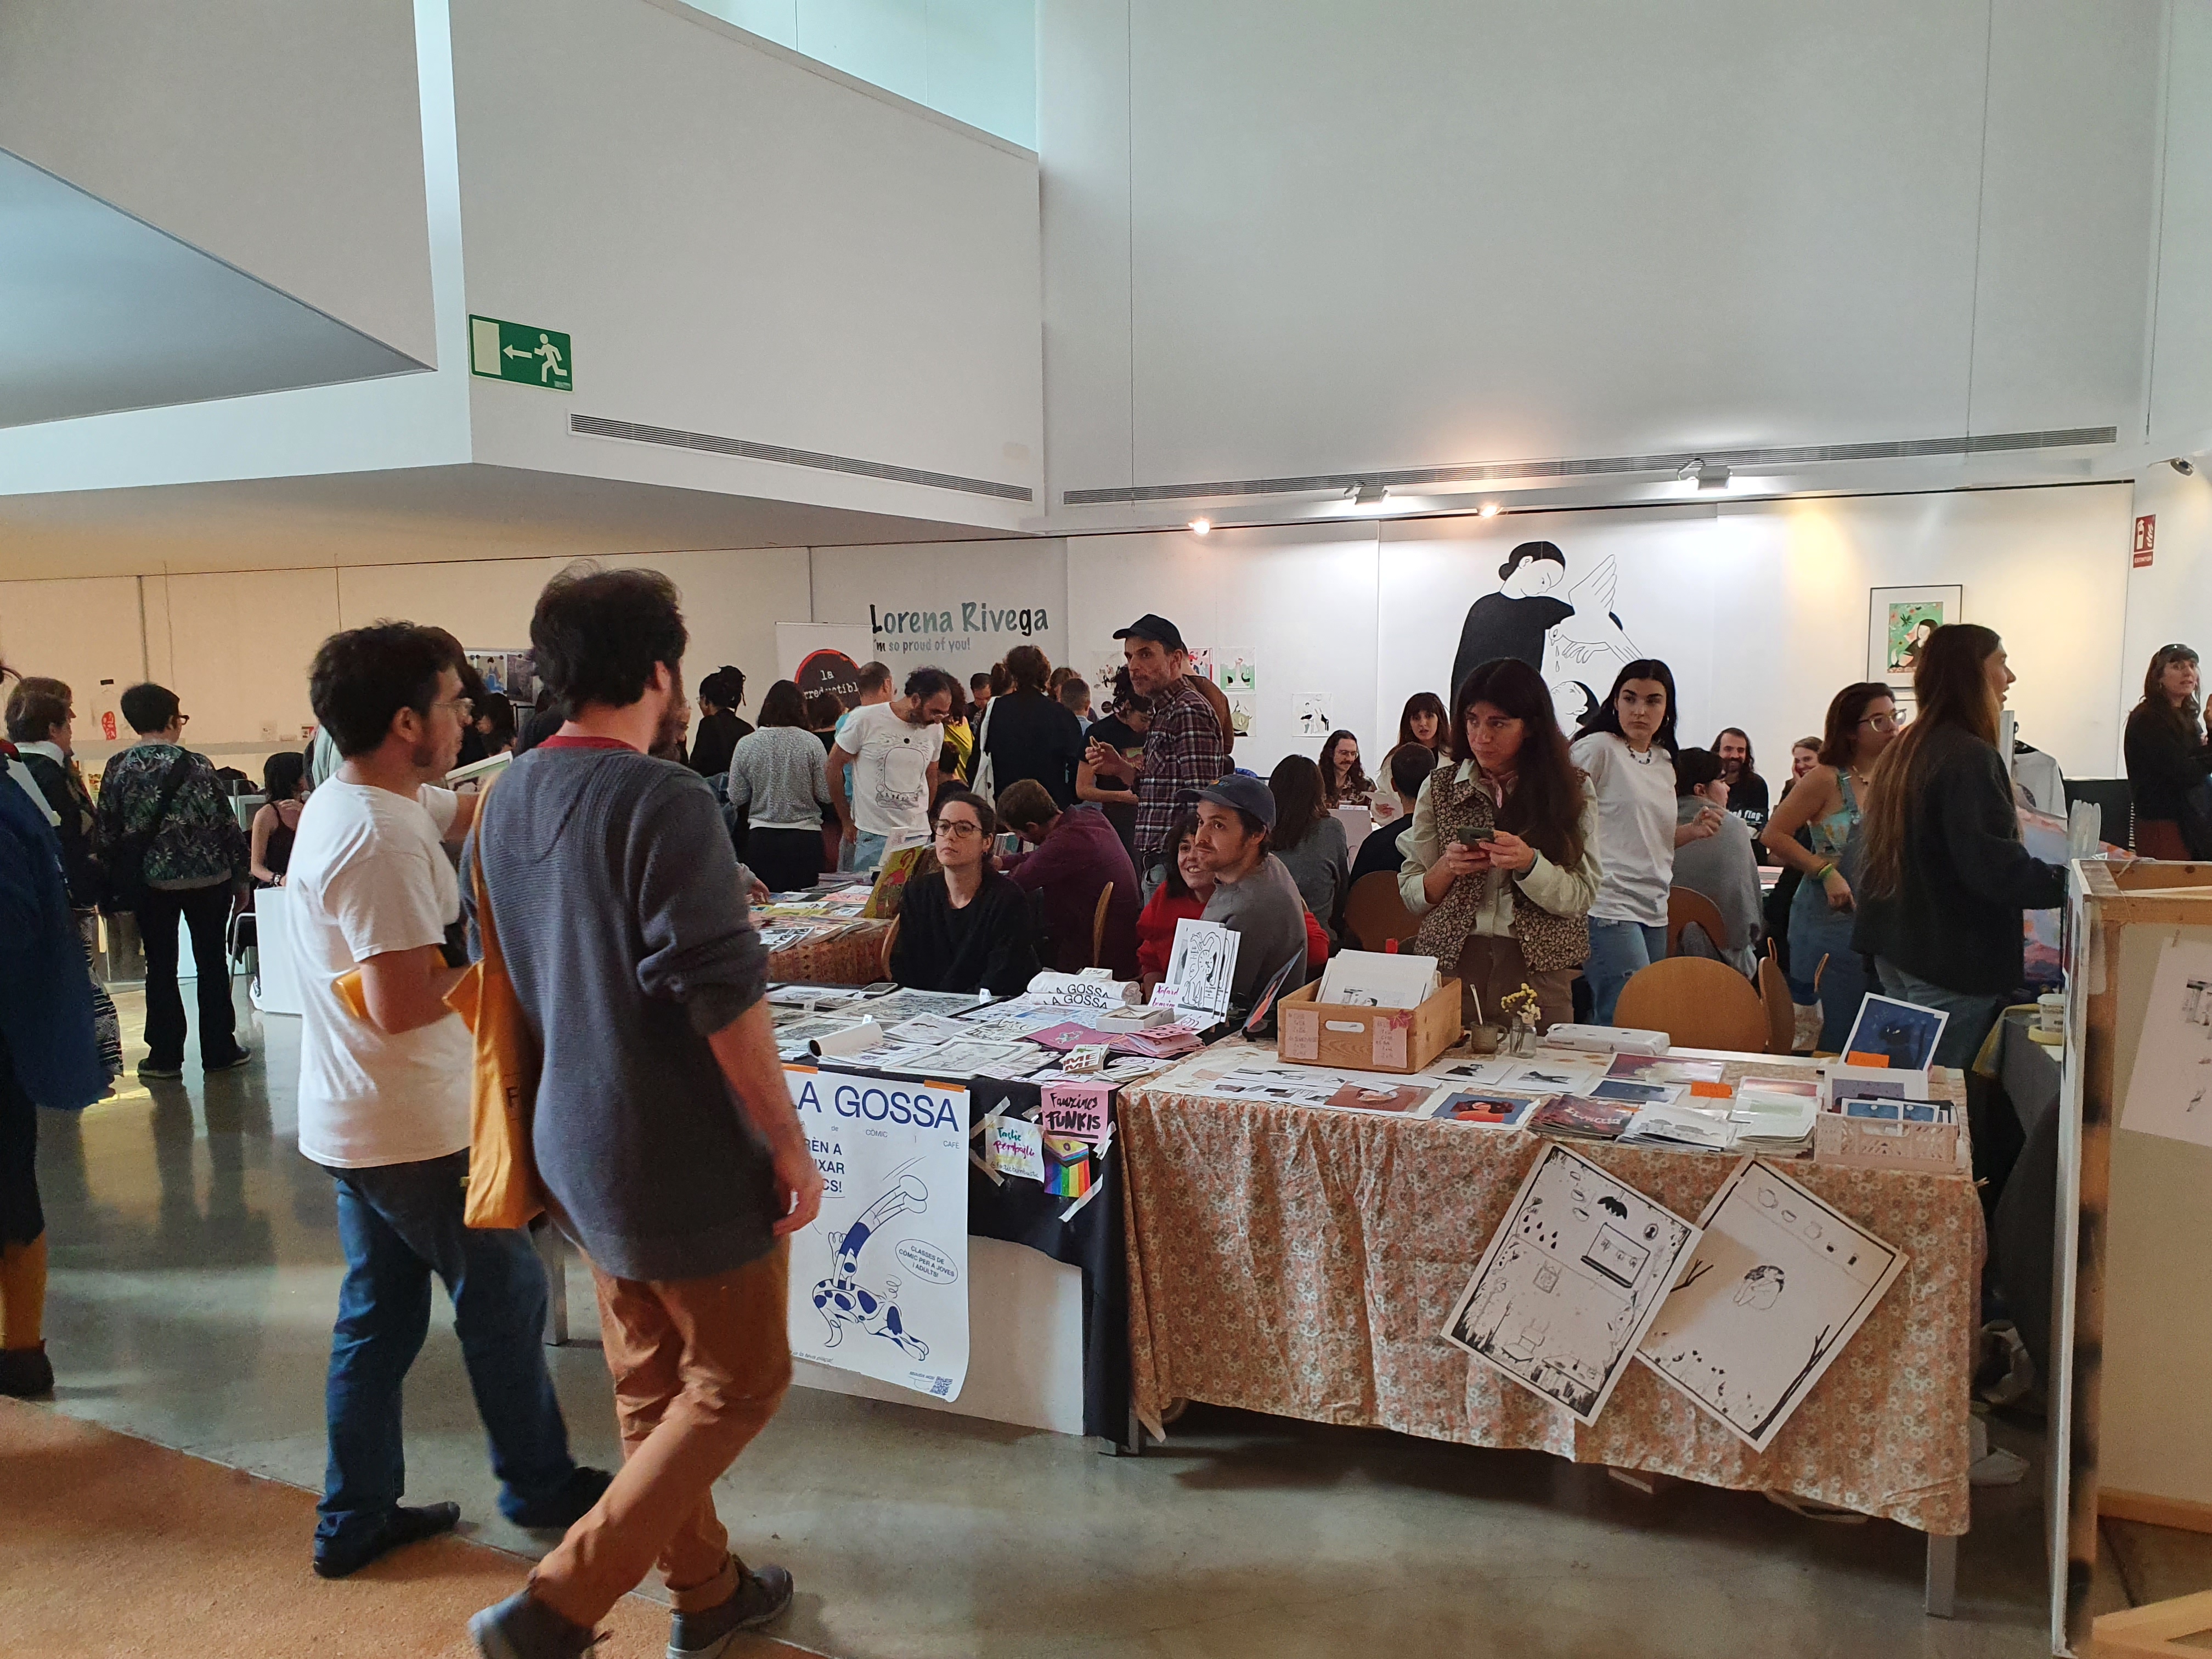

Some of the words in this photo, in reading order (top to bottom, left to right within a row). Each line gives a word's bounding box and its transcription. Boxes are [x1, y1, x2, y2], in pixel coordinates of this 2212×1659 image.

[870, 604, 954, 635] Lorena
[961, 602, 1049, 636] Rivega
[889, 641, 900, 652] so
[902, 638, 932, 654] proud
[934, 638, 945, 651] of
[949, 637, 970, 653] you!
[820, 669, 834, 681] la
[1068, 984, 1109, 998] GOSSA
[1064, 994, 1108, 1009] GOSSA
[794, 1081, 822, 1113] A
[834, 1085, 960, 1132] GOSSA
[1045, 1110, 1102, 1132] PUNKIS
[833, 1143, 843, 1156] A
[911, 1245, 936, 1261] CLASSES
[915, 1264, 939, 1278] ADULTS!
[919, 1257, 930, 1267] PER
[936, 1266, 955, 1277] JOVES
